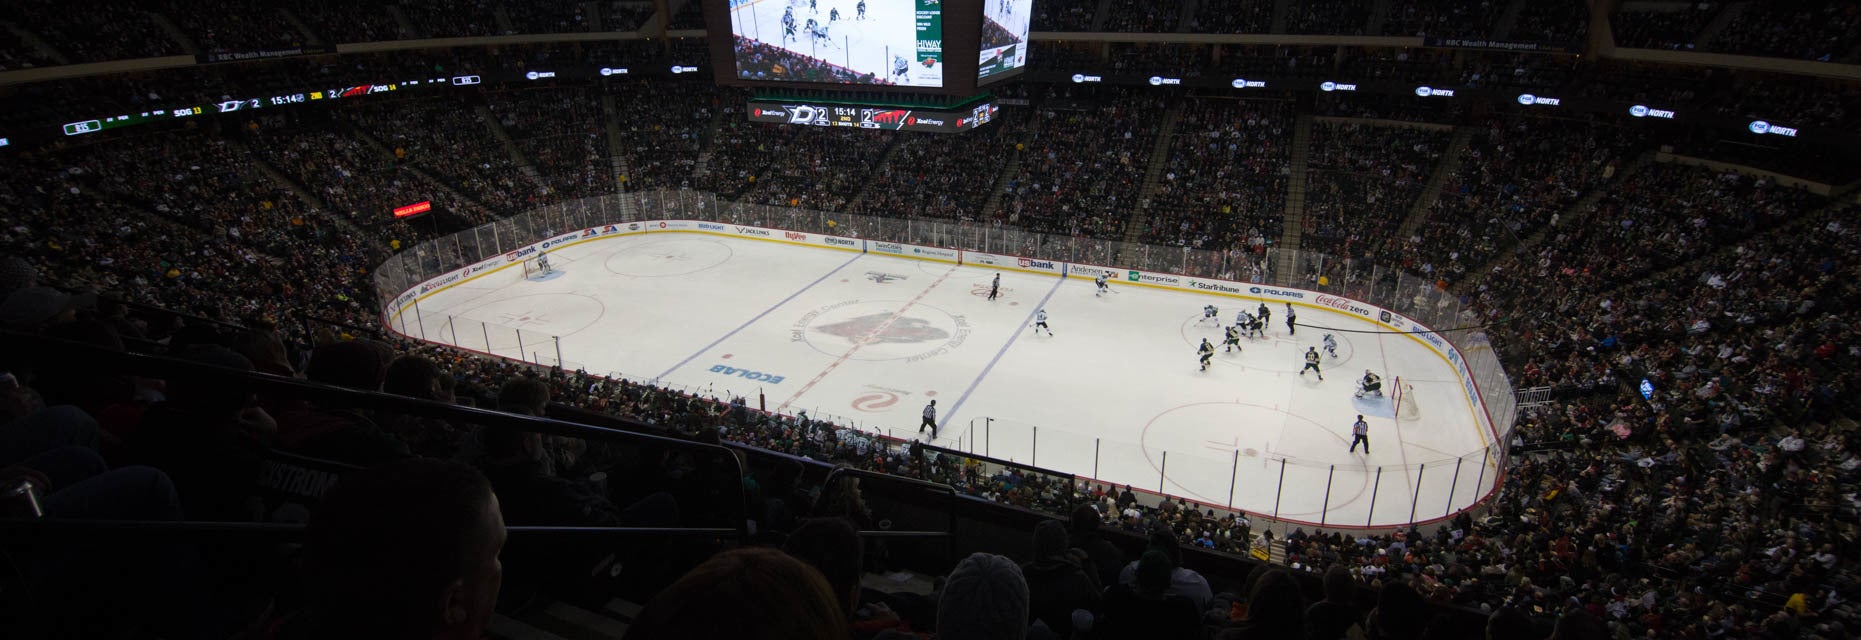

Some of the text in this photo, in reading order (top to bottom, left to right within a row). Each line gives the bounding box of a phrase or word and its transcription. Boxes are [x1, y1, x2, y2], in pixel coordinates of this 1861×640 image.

[916, 40, 942, 48] HIWAY
[1462, 39, 1486, 47] Wealth
[1489, 40, 1537, 50] Management
[260, 48, 303, 57] Management
[1336, 83, 1356, 91] NORTH
[1432, 88, 1454, 96] NORTH
[252, 100, 260, 108] 2
[270, 95, 296, 105] 15:14
[330, 90, 336, 98] 2
[1535, 97, 1560, 106] NORTH
[174, 108, 192, 117] SOG
[818, 107, 871, 122] 2 15:14 2
[1648, 108, 1675, 119] NORTH
[1769, 125, 1797, 137] NORTH
[551, 234, 578, 246] POLARIS
[1071, 264, 1103, 274] Andersen
[1263, 288, 1304, 299] POLARIS
[1349, 305, 1369, 316] zero
[1426, 334, 1443, 347] LIGHT
[709, 364, 786, 385] ECOLAB
